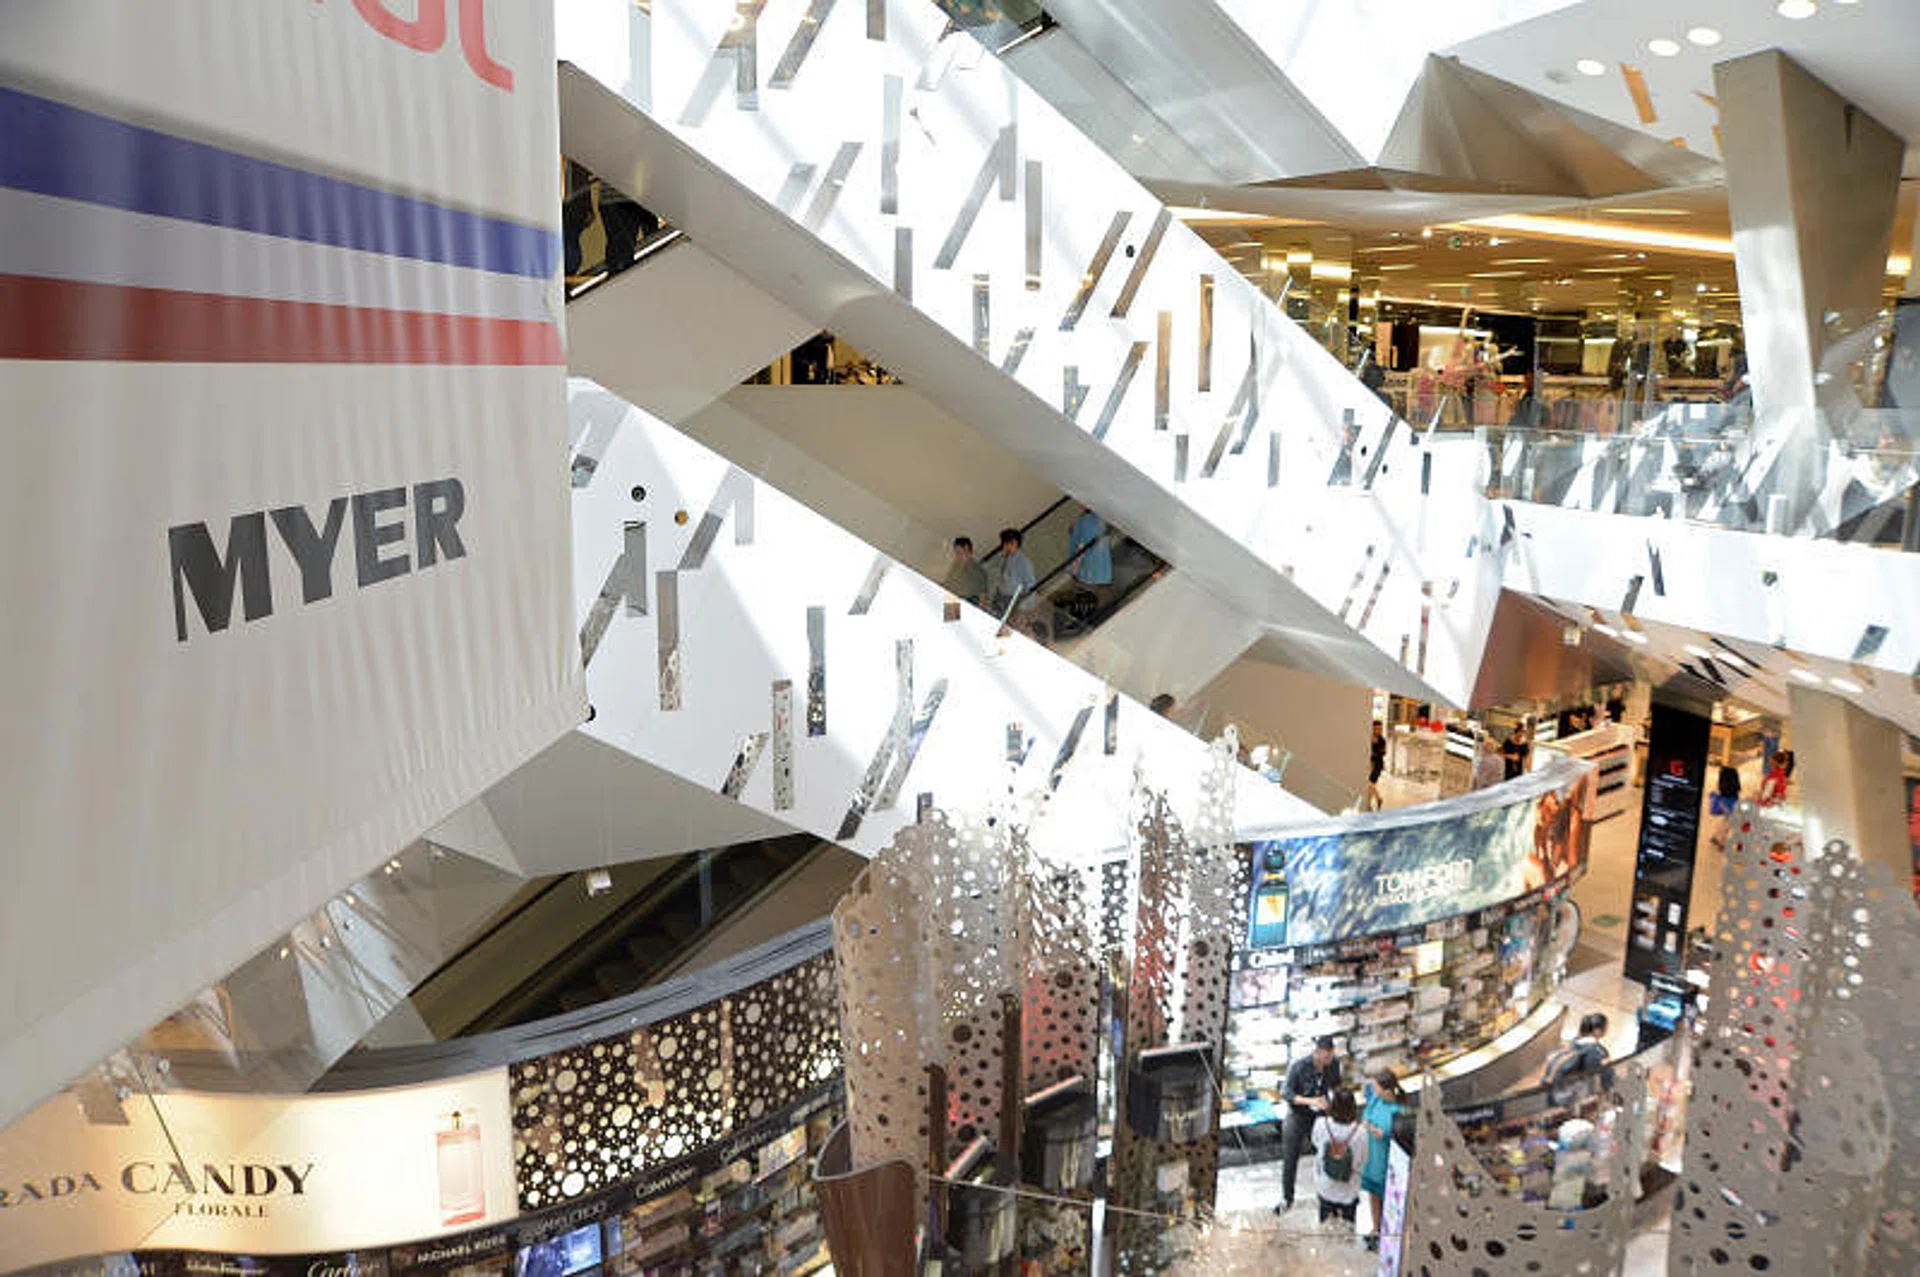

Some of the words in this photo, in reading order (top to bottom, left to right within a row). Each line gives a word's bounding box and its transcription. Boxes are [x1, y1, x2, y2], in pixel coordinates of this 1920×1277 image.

[168, 477, 466, 642] MYER
[119, 1161, 315, 1196] CANDY
[174, 1201, 270, 1219] FLORALE
[417, 1243, 472, 1264] MICHAEL
